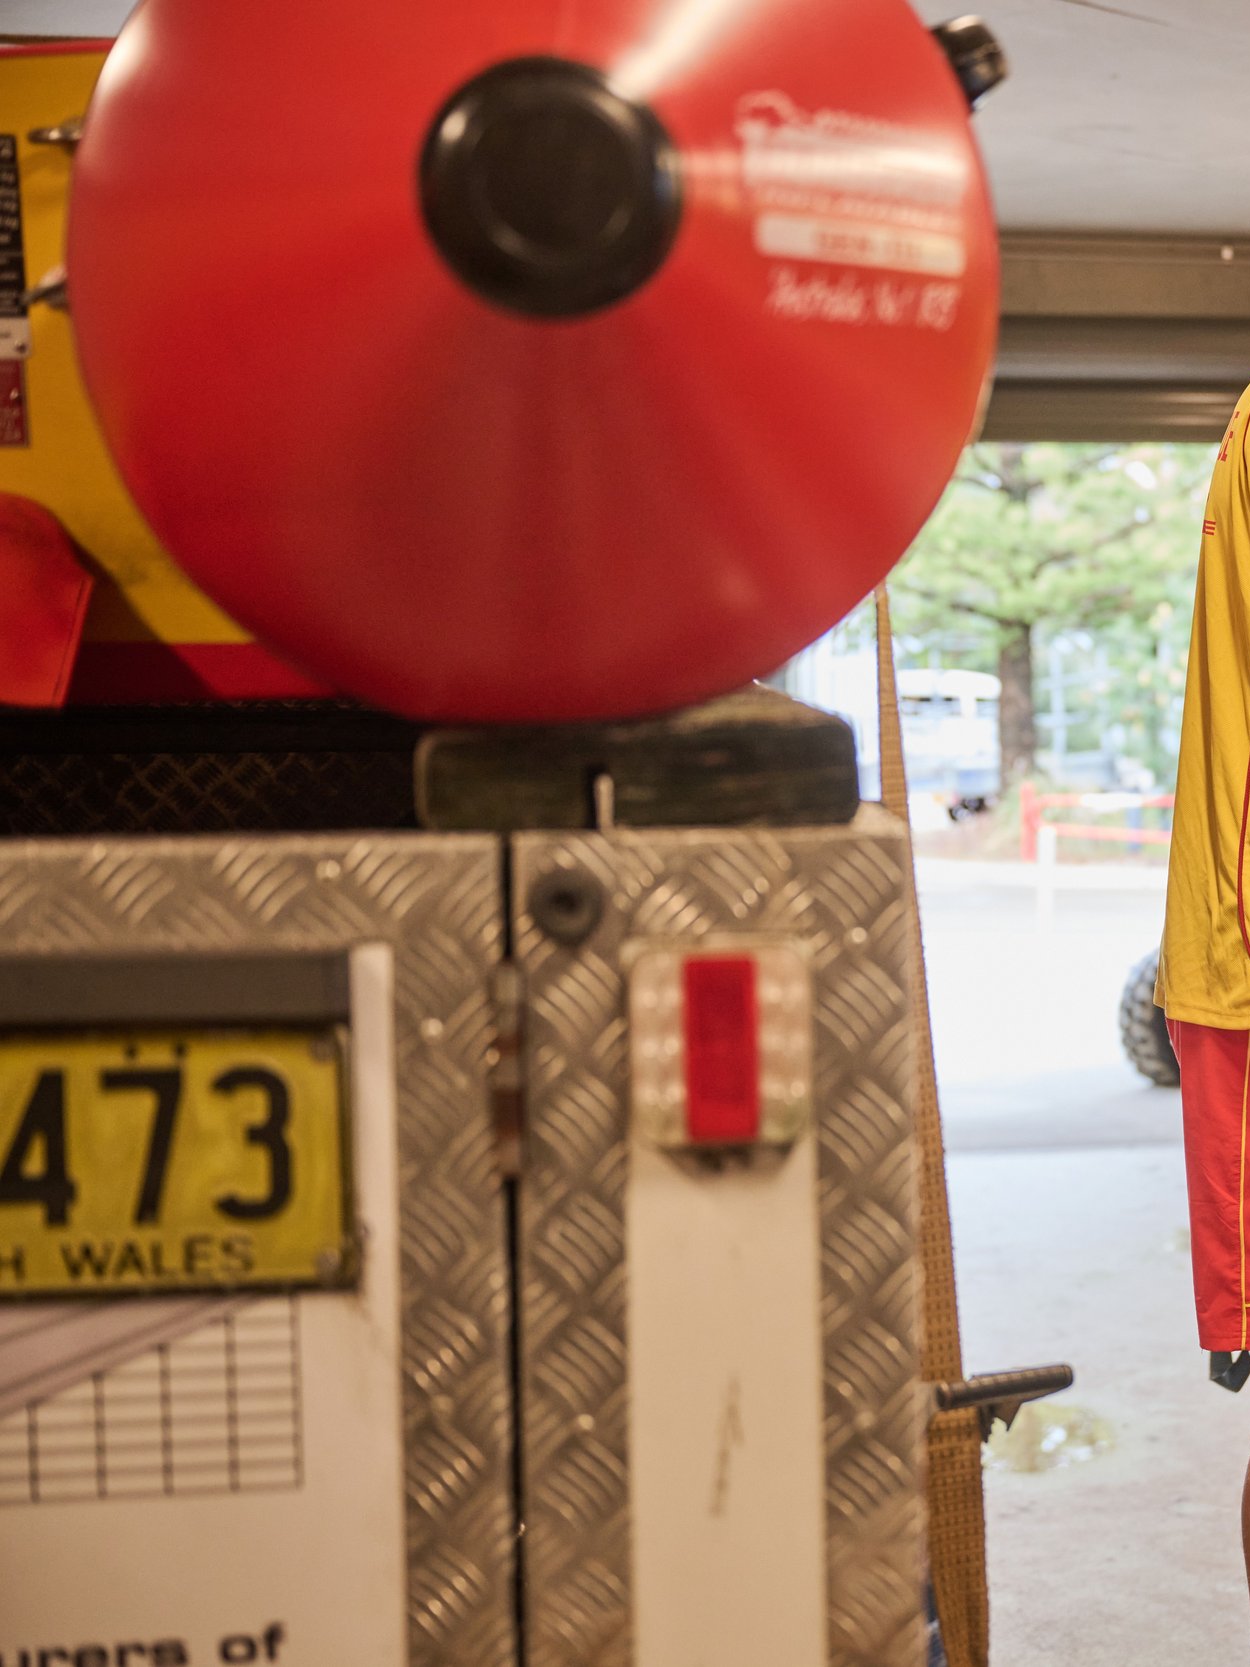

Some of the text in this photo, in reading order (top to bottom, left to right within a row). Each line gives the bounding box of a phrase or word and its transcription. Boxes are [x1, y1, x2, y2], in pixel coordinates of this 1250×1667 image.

[0, 1065, 294, 1229] 473
[60, 1234, 255, 1280] WALES
[218, 1619, 284, 1664] of
